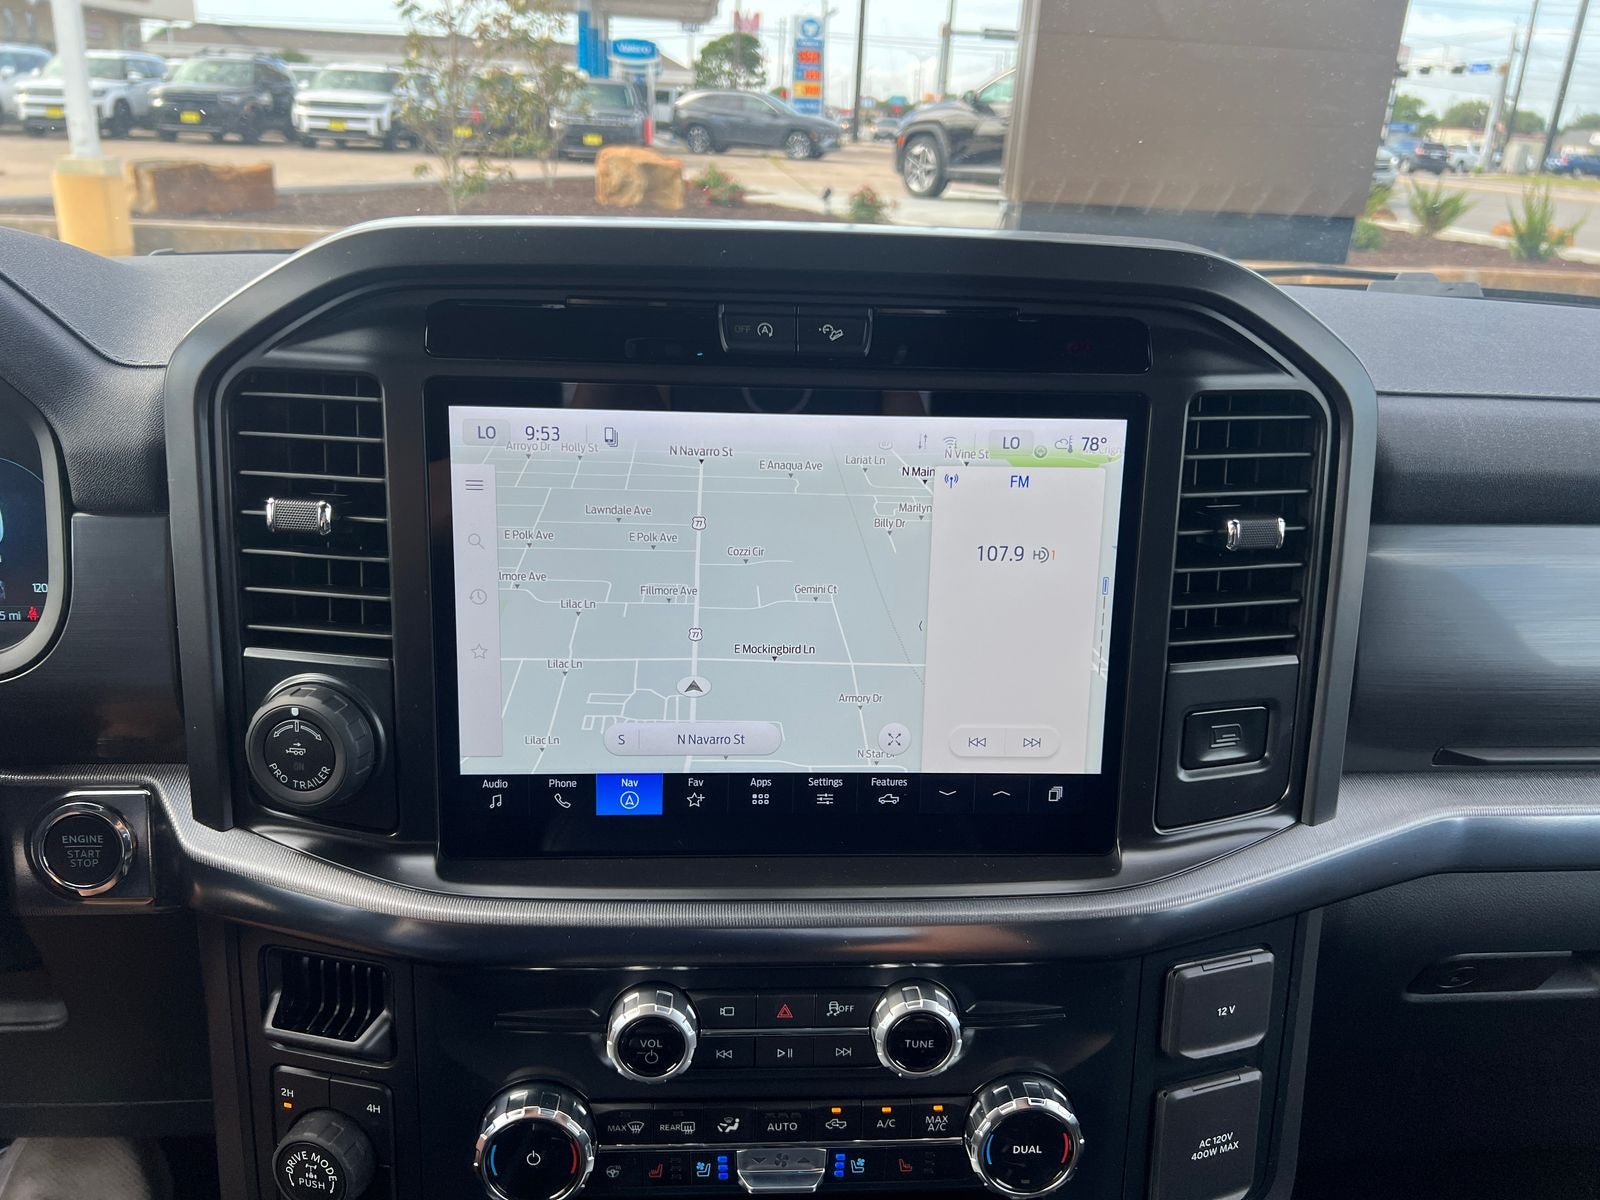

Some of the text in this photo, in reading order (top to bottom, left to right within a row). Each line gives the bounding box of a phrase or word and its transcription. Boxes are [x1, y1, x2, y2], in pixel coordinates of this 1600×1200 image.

[477, 425, 496, 440] LO
[525, 425, 560, 441] 9:53
[505, 441, 551, 452] Arroyo Dr
[561, 442, 599, 454] Holly St
[1002, 436, 1020, 450] LO
[669, 446, 733, 457] N Navarro St
[944, 448, 989, 460] N Vine St
[845, 455, 886, 465] Lariat Ln
[759, 460, 822, 473] E Anaqua Ave
[902, 466, 936, 477] N Main
[1010, 475, 1029, 488] FM
[585, 504, 651, 515] Lawndale Ave
[899, 502, 932, 514] Marilyn
[874, 517, 905, 530] Billy Dr
[504, 530, 554, 540] E Polk Ave
[629, 532, 678, 543] E Polk Ave
[727, 546, 764, 556] Cozzi Cir
[977, 545, 1024, 562] 107.9
[528, 571, 547, 581] Ave
[32, 583, 48, 593] 120
[640, 586, 698, 596] Fillmore Ave
[794, 584, 838, 594] Gemini Ct
[560, 599, 596, 609] Lilac Ln
[8, 611, 21, 620] mi
[734, 643, 815, 656] E Mockingbird Ln
[547, 659, 583, 669] Lilac Ln
[839, 693, 883, 704] Armory Dr
[525, 735, 560, 745] Lilac Ln
[618, 734, 626, 745] S
[677, 734, 745, 745] N Navarro St
[857, 749, 864, 758] N
[866, 749, 884, 758] Star
[269, 762, 331, 789] PRO TRAILER
[482, 778, 508, 789] Audio
[549, 778, 577, 788] Phone
[621, 777, 639, 787] Nav
[688, 777, 704, 787] Fav
[750, 777, 772, 789] Apps
[808, 777, 843, 788] Settings
[871, 776, 908, 787] Features
[62, 834, 104, 844] ENGINE
[67, 849, 101, 859] START
[70, 858, 99, 868] STOP
[838, 1004, 855, 1013] OFF
[1217, 1005, 1236, 1017] 12 V
[639, 1039, 663, 1049] VOL
[905, 1039, 935, 1049] TUNE
[280, 1087, 294, 1098] 2H
[366, 1103, 381, 1114] 4H
[876, 1118, 896, 1129] A/C
[925, 1115, 949, 1124] MAX
[607, 1124, 627, 1132] MAX
[659, 1123, 681, 1131] REAR
[767, 1122, 798, 1131] AUTO
[927, 1122, 947, 1132] A/C
[1199, 1132, 1234, 1149] AC 120V
[1012, 1145, 1042, 1154] DUAL
[1191, 1140, 1239, 1161] 400W MAX
[285, 1150, 338, 1182] DRIVE MODE
[298, 1177, 326, 1190] PUSH
